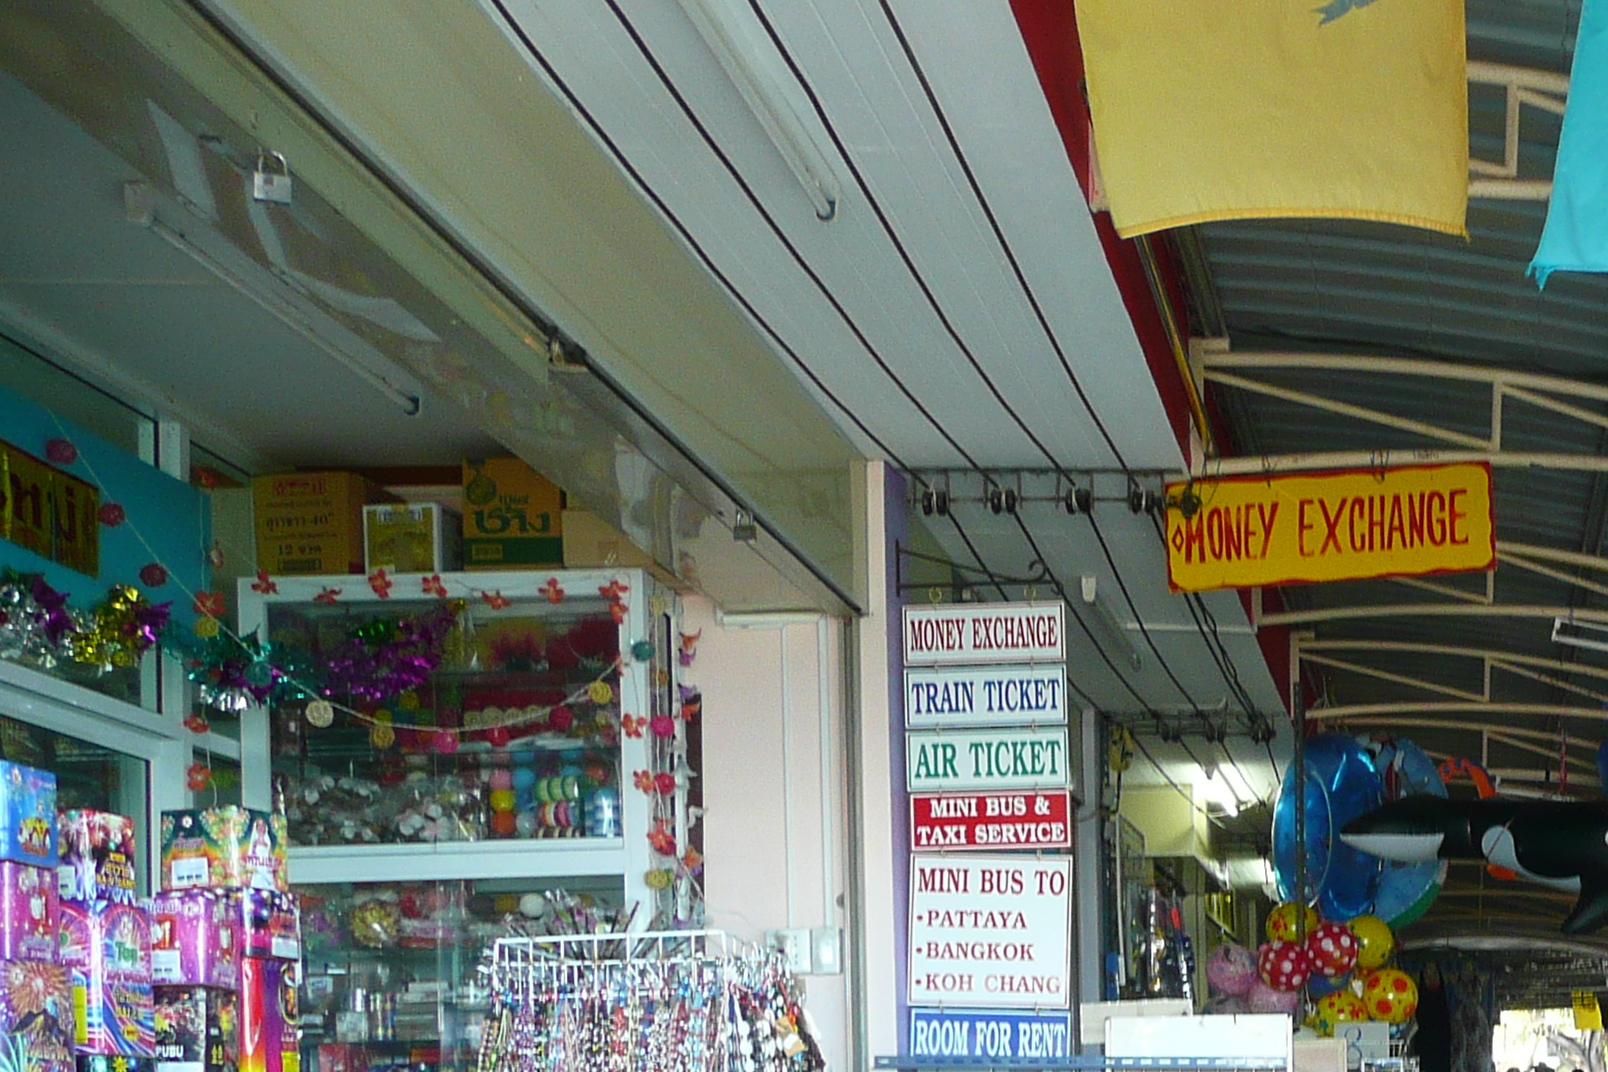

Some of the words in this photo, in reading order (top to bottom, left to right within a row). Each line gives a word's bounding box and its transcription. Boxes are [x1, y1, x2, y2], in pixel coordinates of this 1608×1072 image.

[1185, 502, 1279, 565] MONEY
[1297, 488, 1470, 558] EXCHANGE
[910, 618, 966, 652] MONEY
[971, 615, 1058, 650] EXCHANGE
[911, 681, 975, 714] TRAIN
[983, 678, 1061, 712] TICKET
[914, 742, 959, 779] AIR
[968, 740, 1061, 778] TICKET
[930, 797, 978, 818] MINI
[985, 796, 1027, 816] BUS
[1034, 795, 1050, 815] &
[916, 824, 967, 845] TAXI
[975, 822, 1065, 844] SERVICE
[918, 867, 969, 893] MINI
[980, 868, 1024, 895] BUS
[1034, 870, 1065, 896] TO
[926, 909, 1028, 930] PATTAYA
[925, 941, 1035, 961] BANGKOK
[925, 973, 974, 992] KOH
[984, 974, 1061, 994] CHANG
[915, 1019, 970, 1056] ROOM
[974, 1020, 1012, 1057] FOR
[1017, 1021, 1066, 1057] RENT
